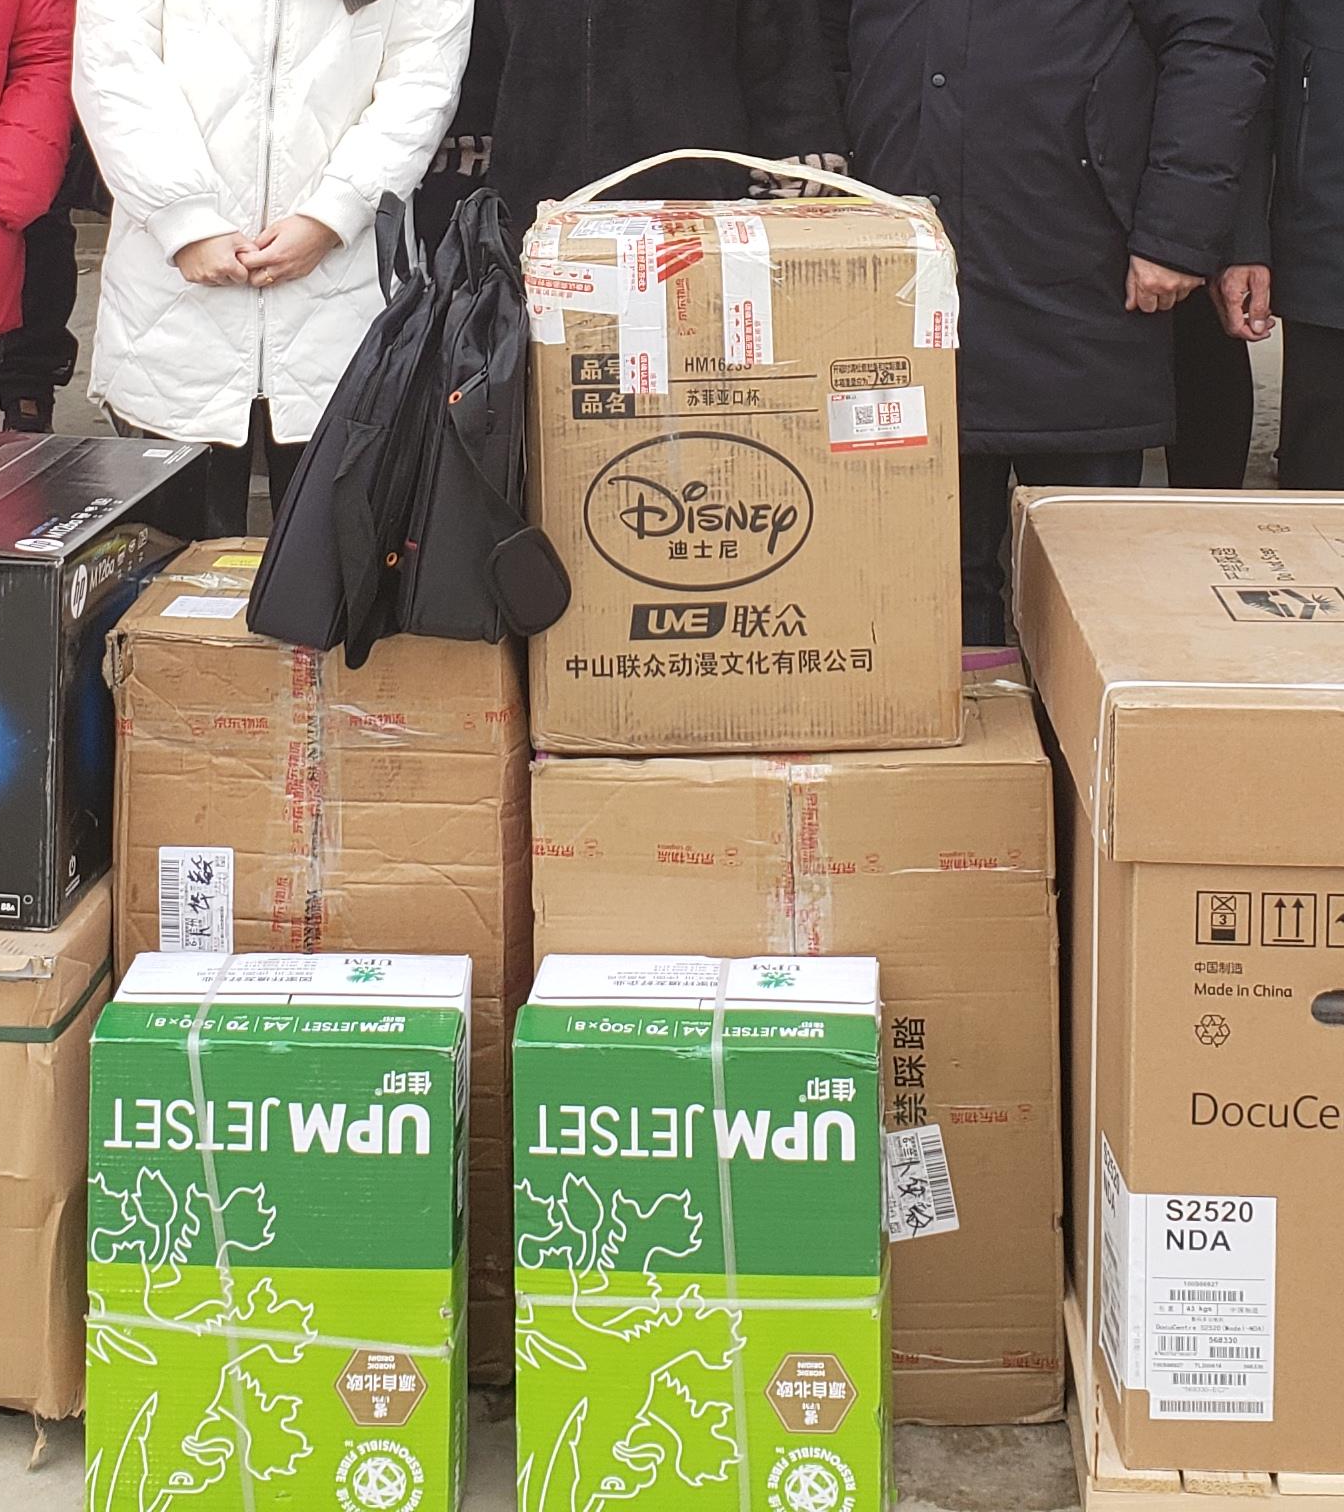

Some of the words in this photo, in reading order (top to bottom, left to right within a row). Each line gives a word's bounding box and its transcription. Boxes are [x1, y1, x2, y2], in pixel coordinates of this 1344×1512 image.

[581, 393, 627, 414] 品名
[686, 389, 760, 407] 苏菲亚口杯
[668, 540, 739, 560] 迪士尼
[732, 603, 808, 638] 联众
[565, 648, 874, 680] 中山联众动漫文化有限公司
[344, 958, 393, 966] UPM
[752, 964, 801, 972] UPM
[1194, 961, 1243, 975] 中国制造
[1194, 983, 1234, 997] Made
[1236, 984, 1250, 997] in
[1253, 983, 1293, 998] China
[226, 1021, 249, 1032] 70
[264, 1020, 294, 1032] A4
[301, 1021, 360, 1033] JETSET
[359, 1021, 406, 1032] UPM
[645, 1025, 669, 1036] 70
[683, 1025, 713, 1037] A4
[722, 1026, 780, 1037] JETSET
[779, 1028, 825, 1038] UPM
[383, 1071, 433, 1096] 佳印
[806, 1077, 856, 1103] 佳印
[103, 1097, 282, 1153] JETSET
[288, 1102, 432, 1155] UPM
[528, 1103, 705, 1159] JETSET
[712, 1109, 856, 1162] UPM
[1166, 1199, 1254, 1223] S2520
[1166, 1229, 1232, 1252] NDA
[367, 1362, 396, 1370] NORDIC
[346, 1373, 417, 1393] 源自北欧
[775, 1380, 847, 1400] 源自北欧
[335, 1449, 359, 1484] FIBRE
[356, 1439, 425, 1484] RESPONSIBLE
[788, 1445, 857, 1491] RESPONSIBLE
[767, 1456, 790, 1490] FIBRE
